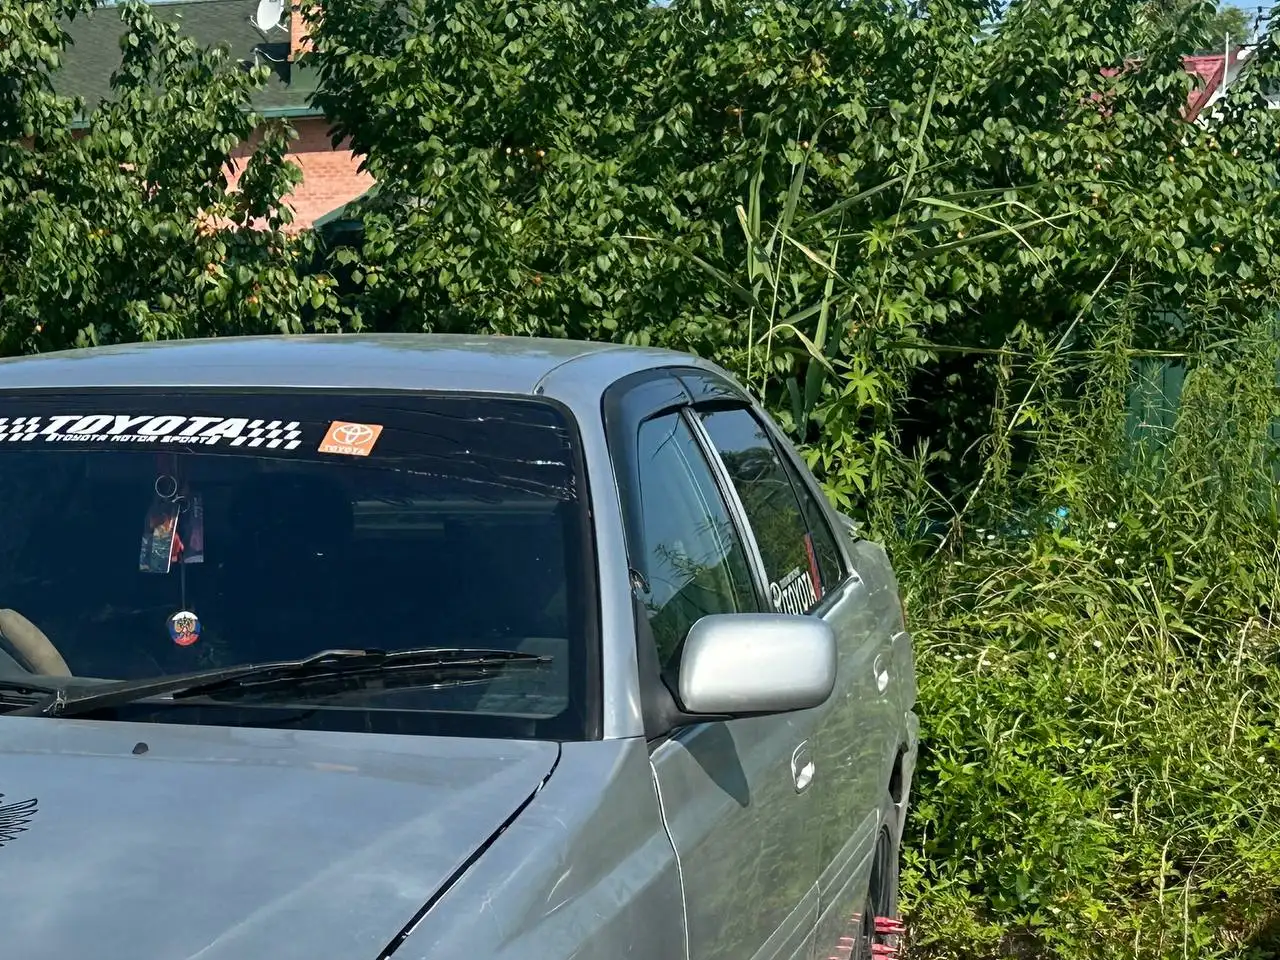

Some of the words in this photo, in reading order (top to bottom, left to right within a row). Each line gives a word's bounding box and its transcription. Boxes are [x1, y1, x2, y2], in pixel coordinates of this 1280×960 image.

[41, 415, 249, 439] TOYOTA
[55, 433, 108, 442] TOYOTA
[111, 434, 158, 443] MOTOR
[782, 570, 818, 615] TOYOTA
